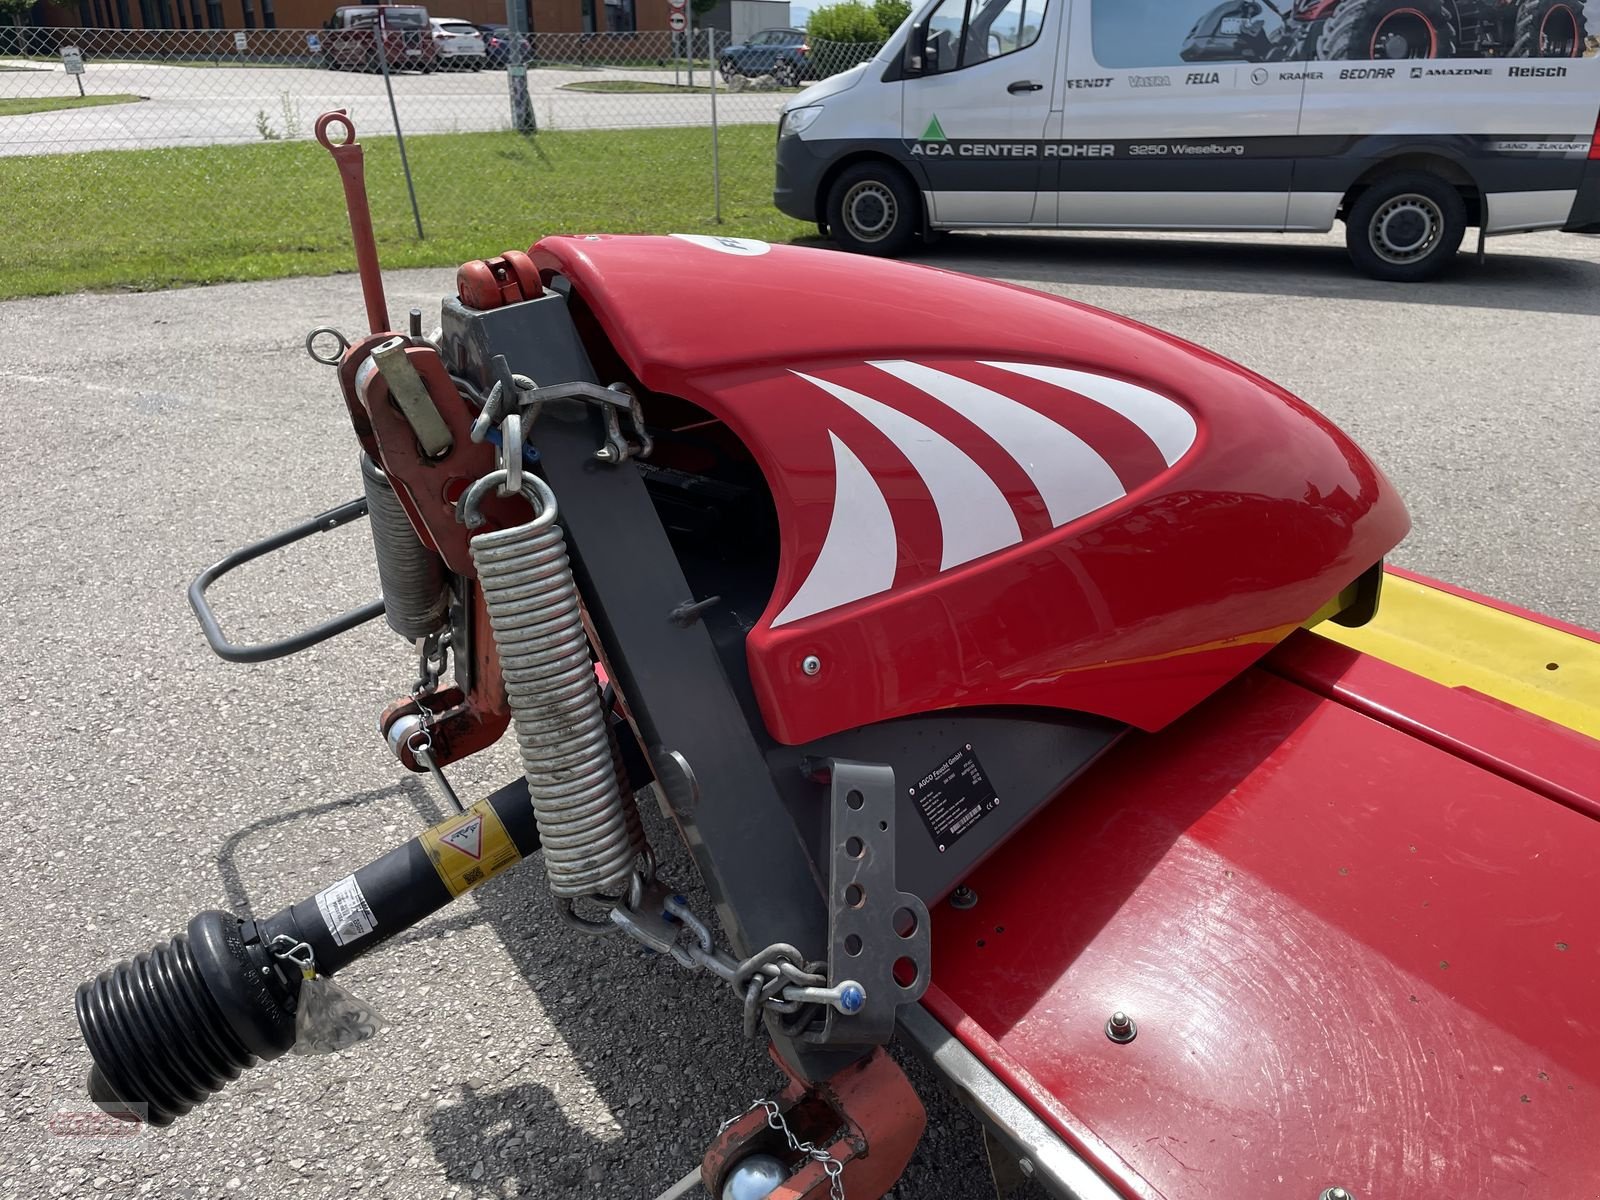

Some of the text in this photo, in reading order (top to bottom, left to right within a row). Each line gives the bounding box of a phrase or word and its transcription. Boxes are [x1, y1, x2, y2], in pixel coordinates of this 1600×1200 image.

[1279, 71, 1324, 81] KRAMER
[1339, 68, 1395, 80] BEDNAR
[1425, 68, 1493, 76] AMAZONE
[1508, 66, 1567, 77] Reisch
[1067, 77, 1114, 89] FENDT
[1185, 72, 1219, 85] FELLA
[910, 143, 1245, 157] ACA CENTER ROHER 3250 Wieselburg
[918, 774, 934, 789] AGCO
[932, 761, 950, 776] Feucht
[947, 751, 963, 766] GmbH
